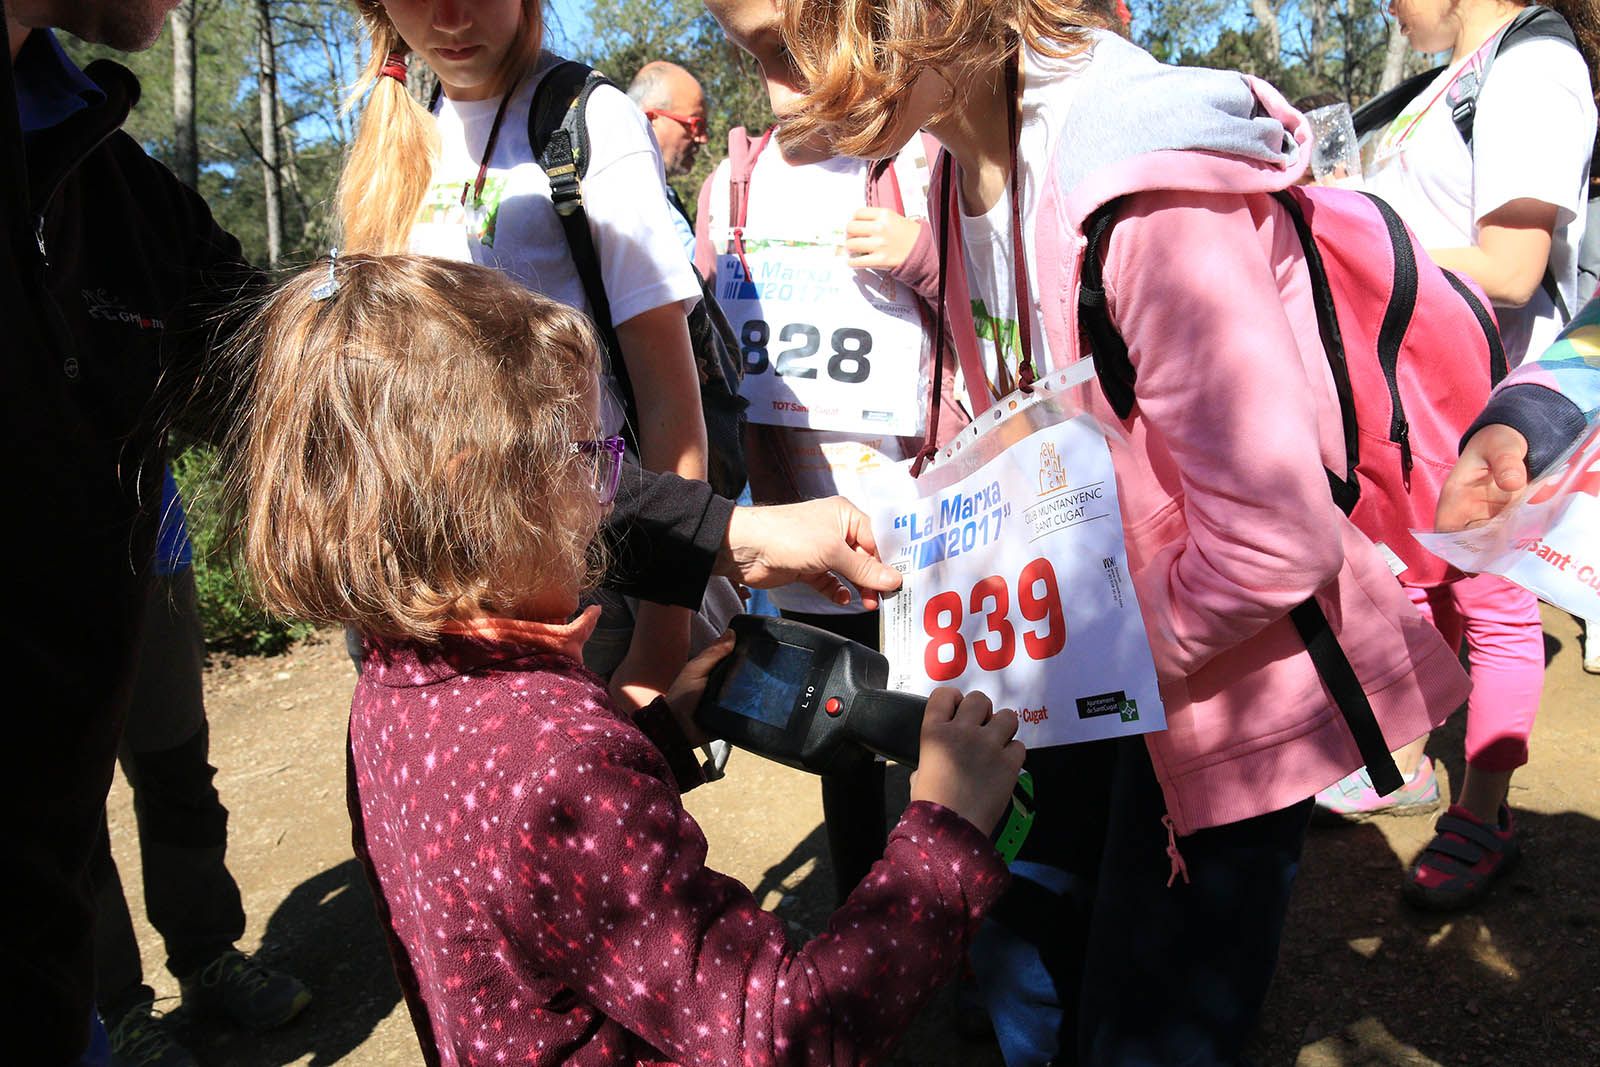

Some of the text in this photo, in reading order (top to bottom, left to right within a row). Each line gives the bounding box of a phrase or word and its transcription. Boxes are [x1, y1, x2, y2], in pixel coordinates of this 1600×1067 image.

[741, 319, 873, 384] 828
[772, 401, 790, 411] TOT
[939, 480, 1002, 529] Marxa
[1038, 488, 1103, 516] MUNTANYENC
[1035, 506, 1085, 534] SANT CUGAT
[923, 556, 1067, 682] 839
[1023, 706, 1048, 724] Cugat
